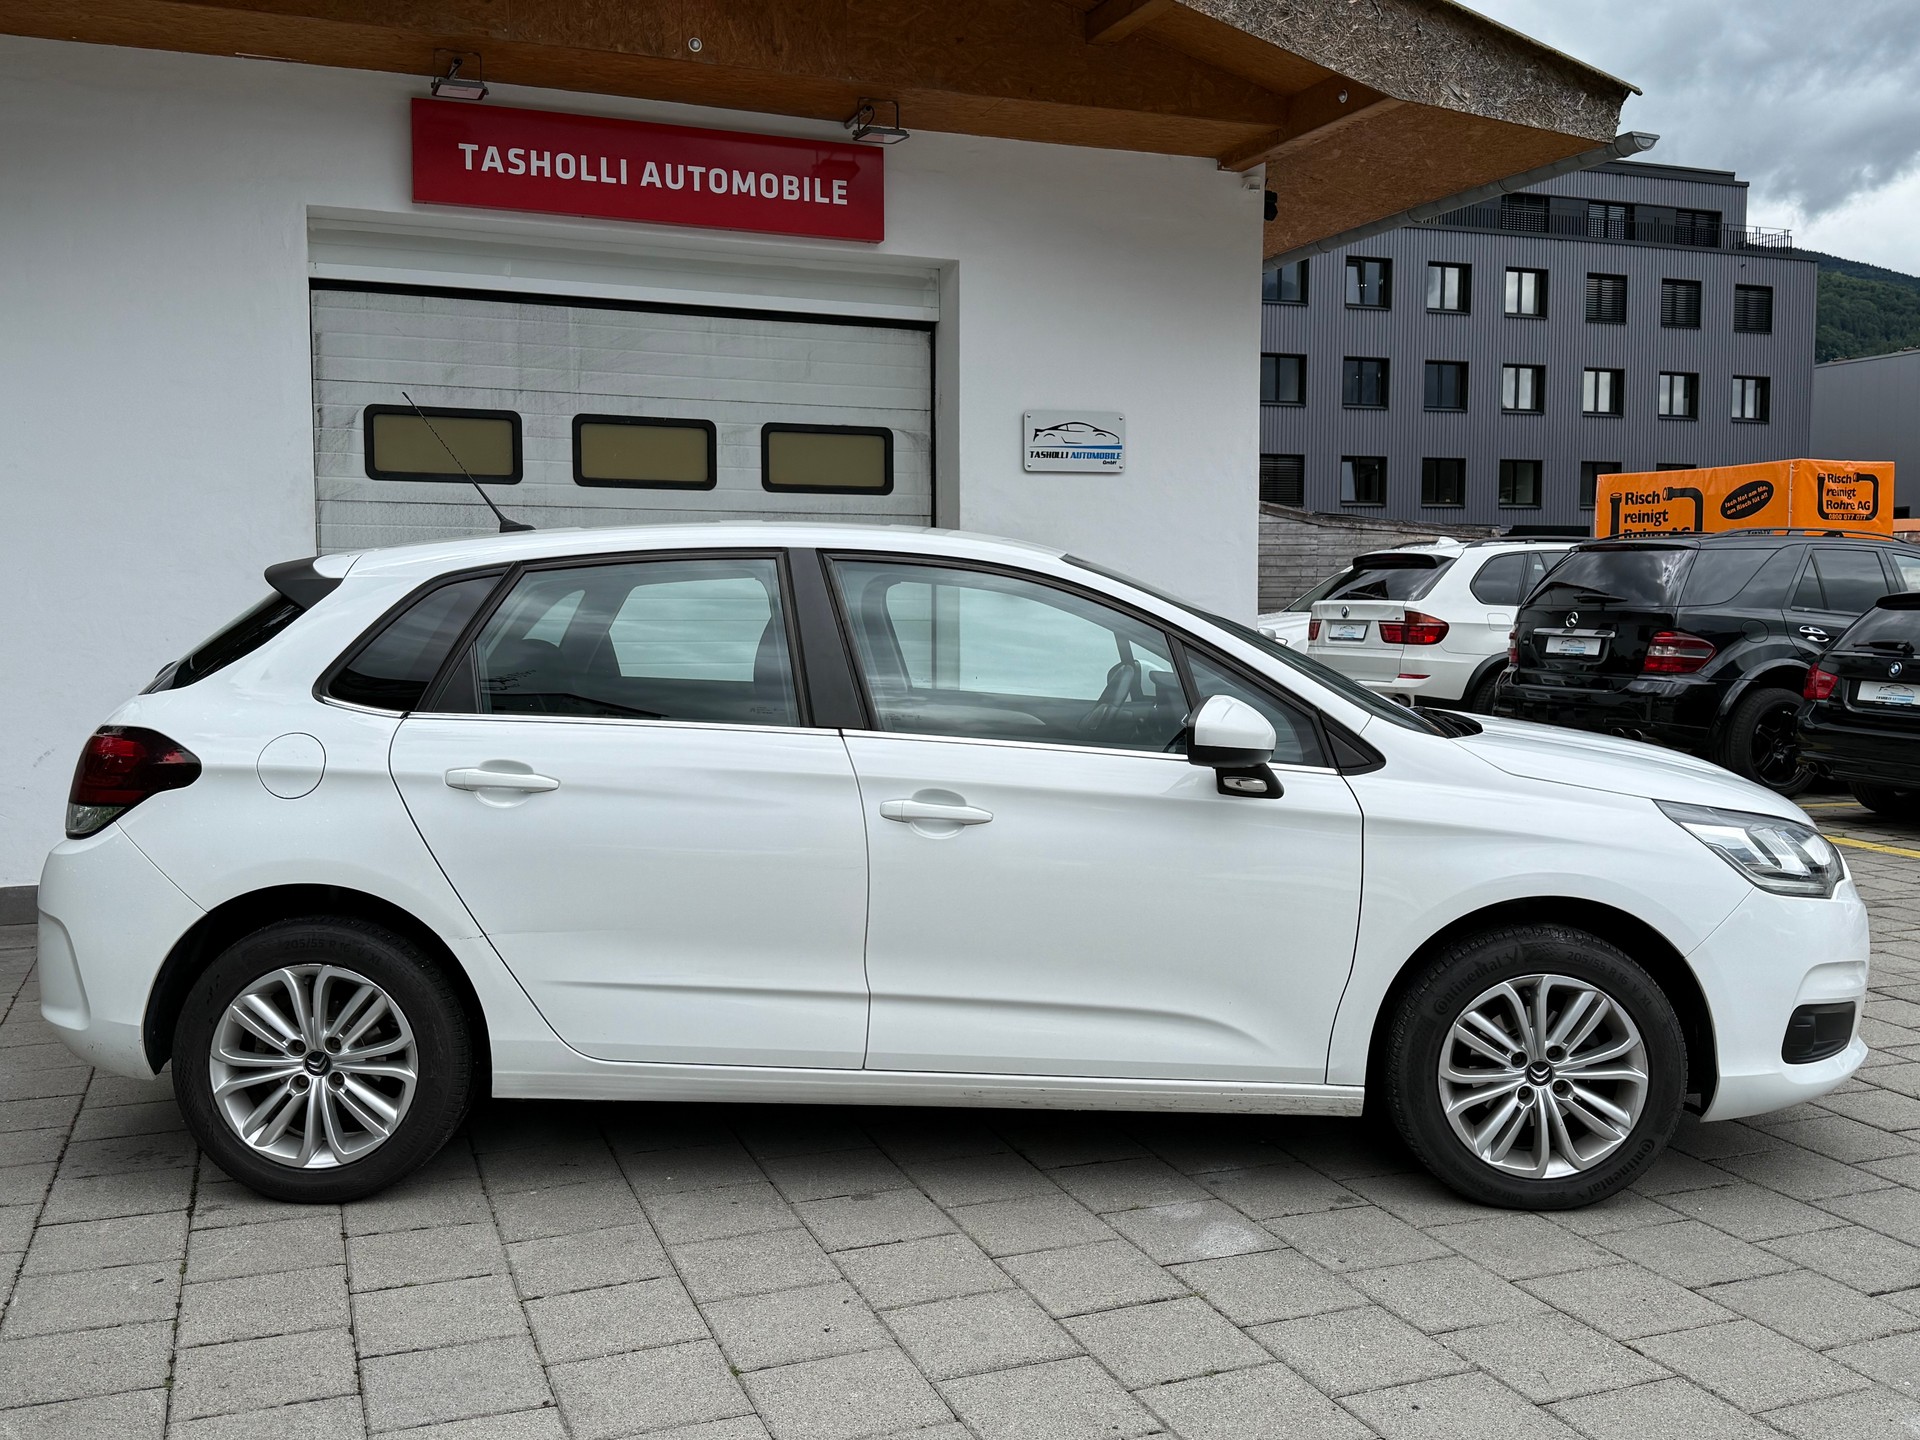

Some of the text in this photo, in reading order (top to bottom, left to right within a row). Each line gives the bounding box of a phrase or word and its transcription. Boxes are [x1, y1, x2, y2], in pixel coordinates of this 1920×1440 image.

[457, 142, 848, 206] TASHOLLI AUTOMOBILE
[1029, 450, 1122, 460] TASHOLLI AUTOMOBILE
[1827, 473, 1852, 484] Risch
[1624, 490, 1660, 506] Risch
[1826, 487, 1857, 500] reinigt
[1826, 500, 1871, 511] Rohre AG
[1624, 508, 1669, 527] reinigt
[1567, 951, 1607, 971] 205/55
[1608, 966, 1617, 978] R
[1618, 973, 1630, 985] 16
[1434, 955, 1503, 1015] Continental
[1587, 1138, 1656, 1197] Continental
